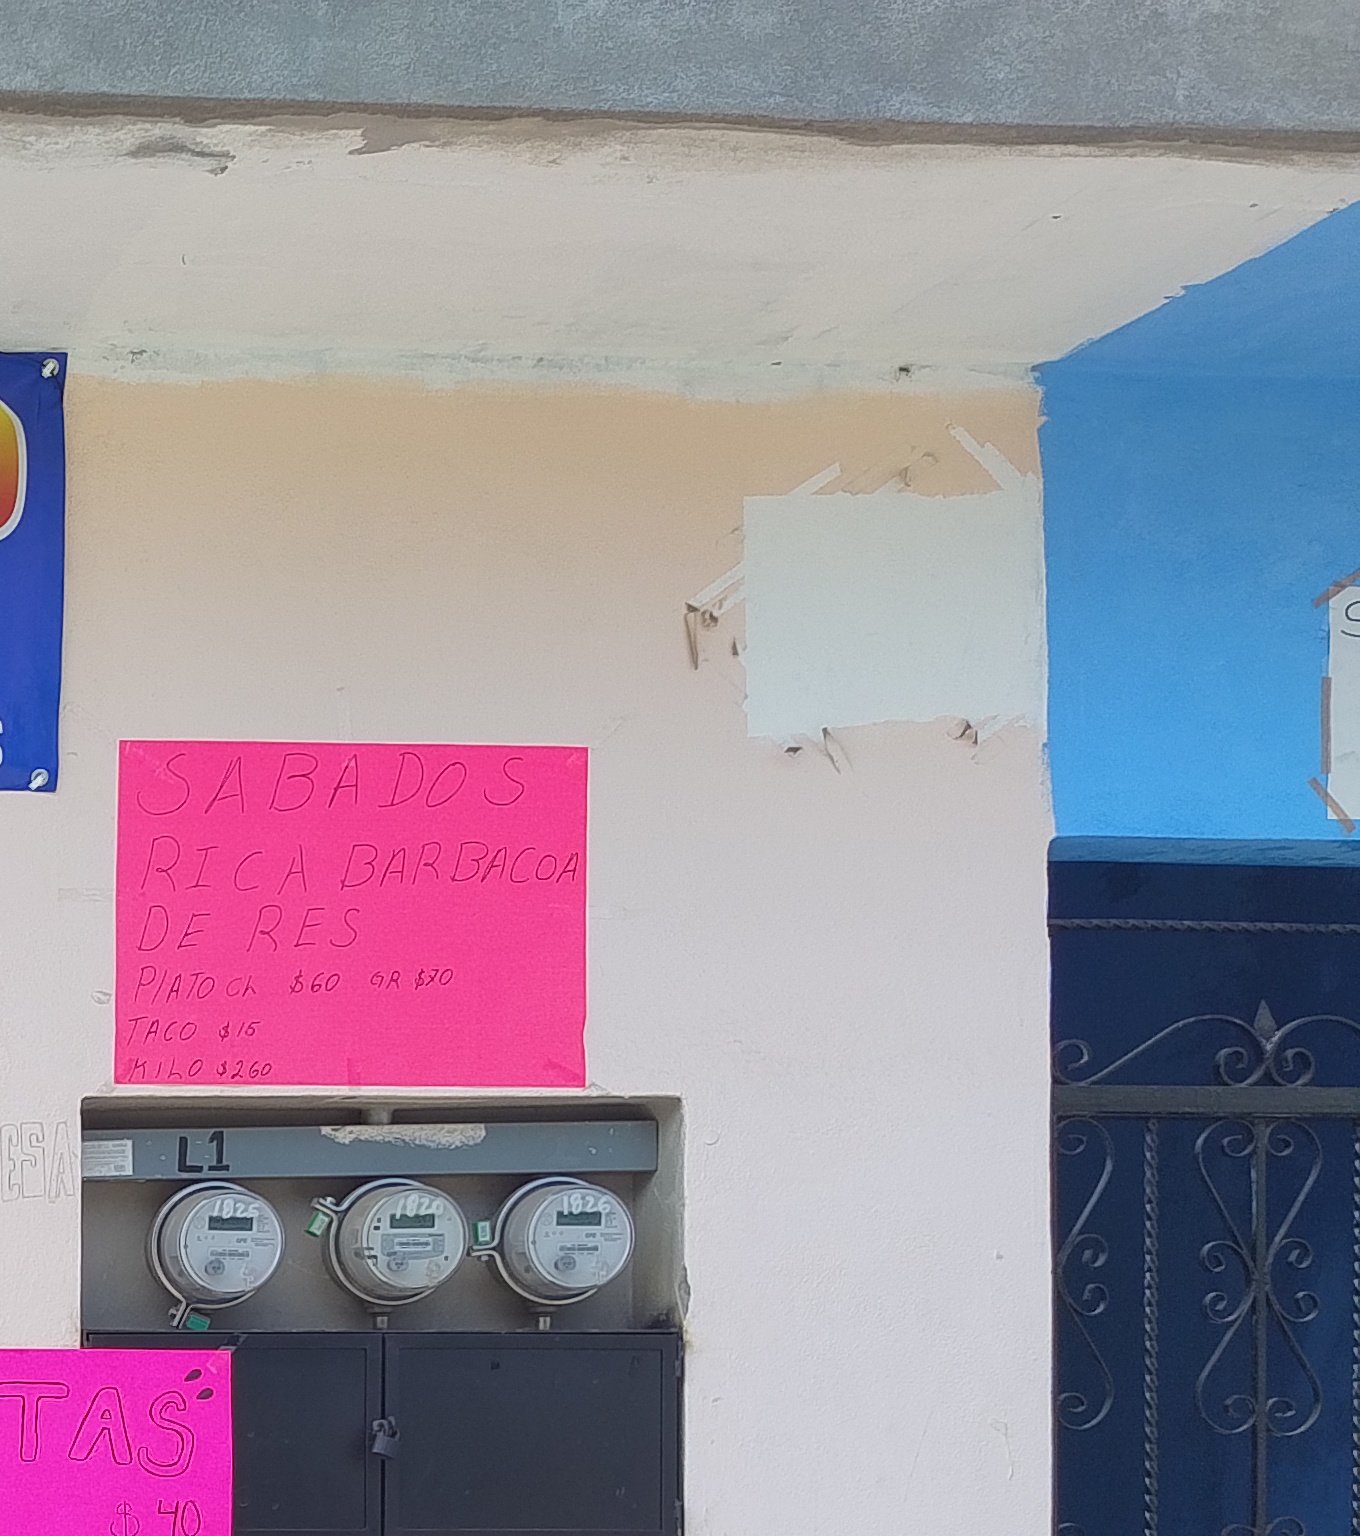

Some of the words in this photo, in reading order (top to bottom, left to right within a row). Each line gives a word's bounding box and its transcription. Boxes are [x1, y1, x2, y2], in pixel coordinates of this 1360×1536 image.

[136, 751, 526, 816] SABADOS
[140, 835, 308, 896] RICA
[340, 841, 580, 892] BARBACOA
[137, 905, 211, 952] DE
[246, 904, 361, 953] RES
[289, 969, 340, 994] $60
[127, 1016, 197, 1046] TACO
[218, 1021, 261, 1042] $15
[129, 1058, 203, 1082] KILO
[216, 1059, 272, 1079] $260
[178, 1130, 230, 1173] L1
